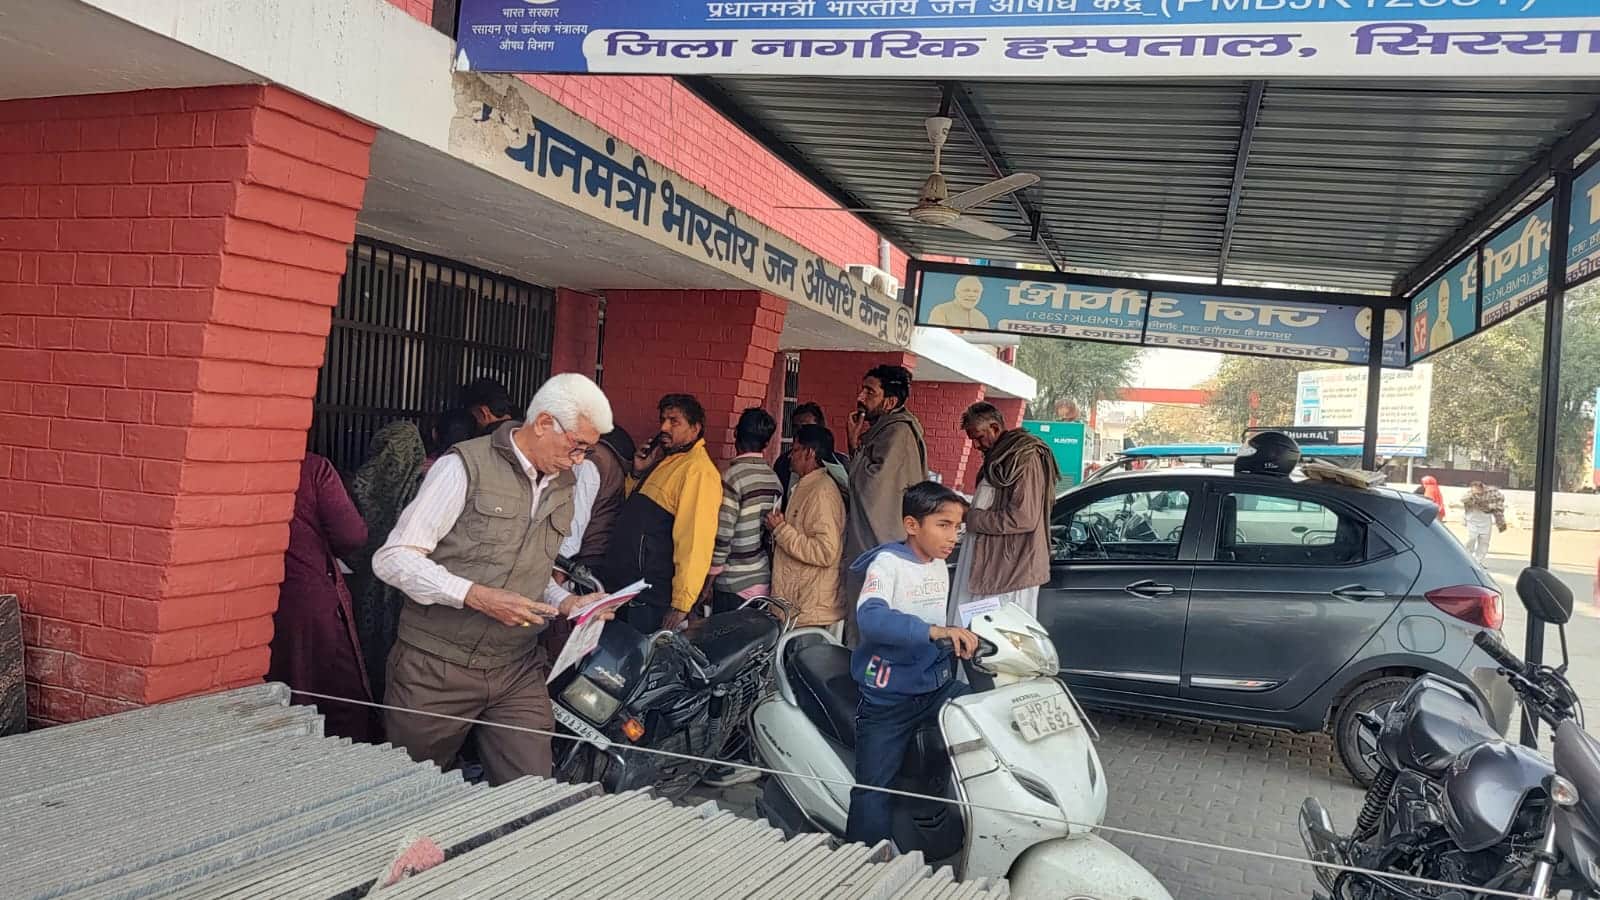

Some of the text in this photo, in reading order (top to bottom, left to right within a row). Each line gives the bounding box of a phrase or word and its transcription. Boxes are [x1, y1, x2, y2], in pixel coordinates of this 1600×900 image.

[502, 7, 559, 18] भारत सरकार
[504, 22, 518, 36] एवं
[554, 22, 588, 35] मंत्रालय
[527, 37, 555, 51] विभाग
[603, 22, 1600, 59] जिला नागरिक हस्पताल, सिरसा
[661, 180, 759, 273] भारतीय
[763, 243, 798, 292] जन
[802, 257, 857, 319] औषधि
